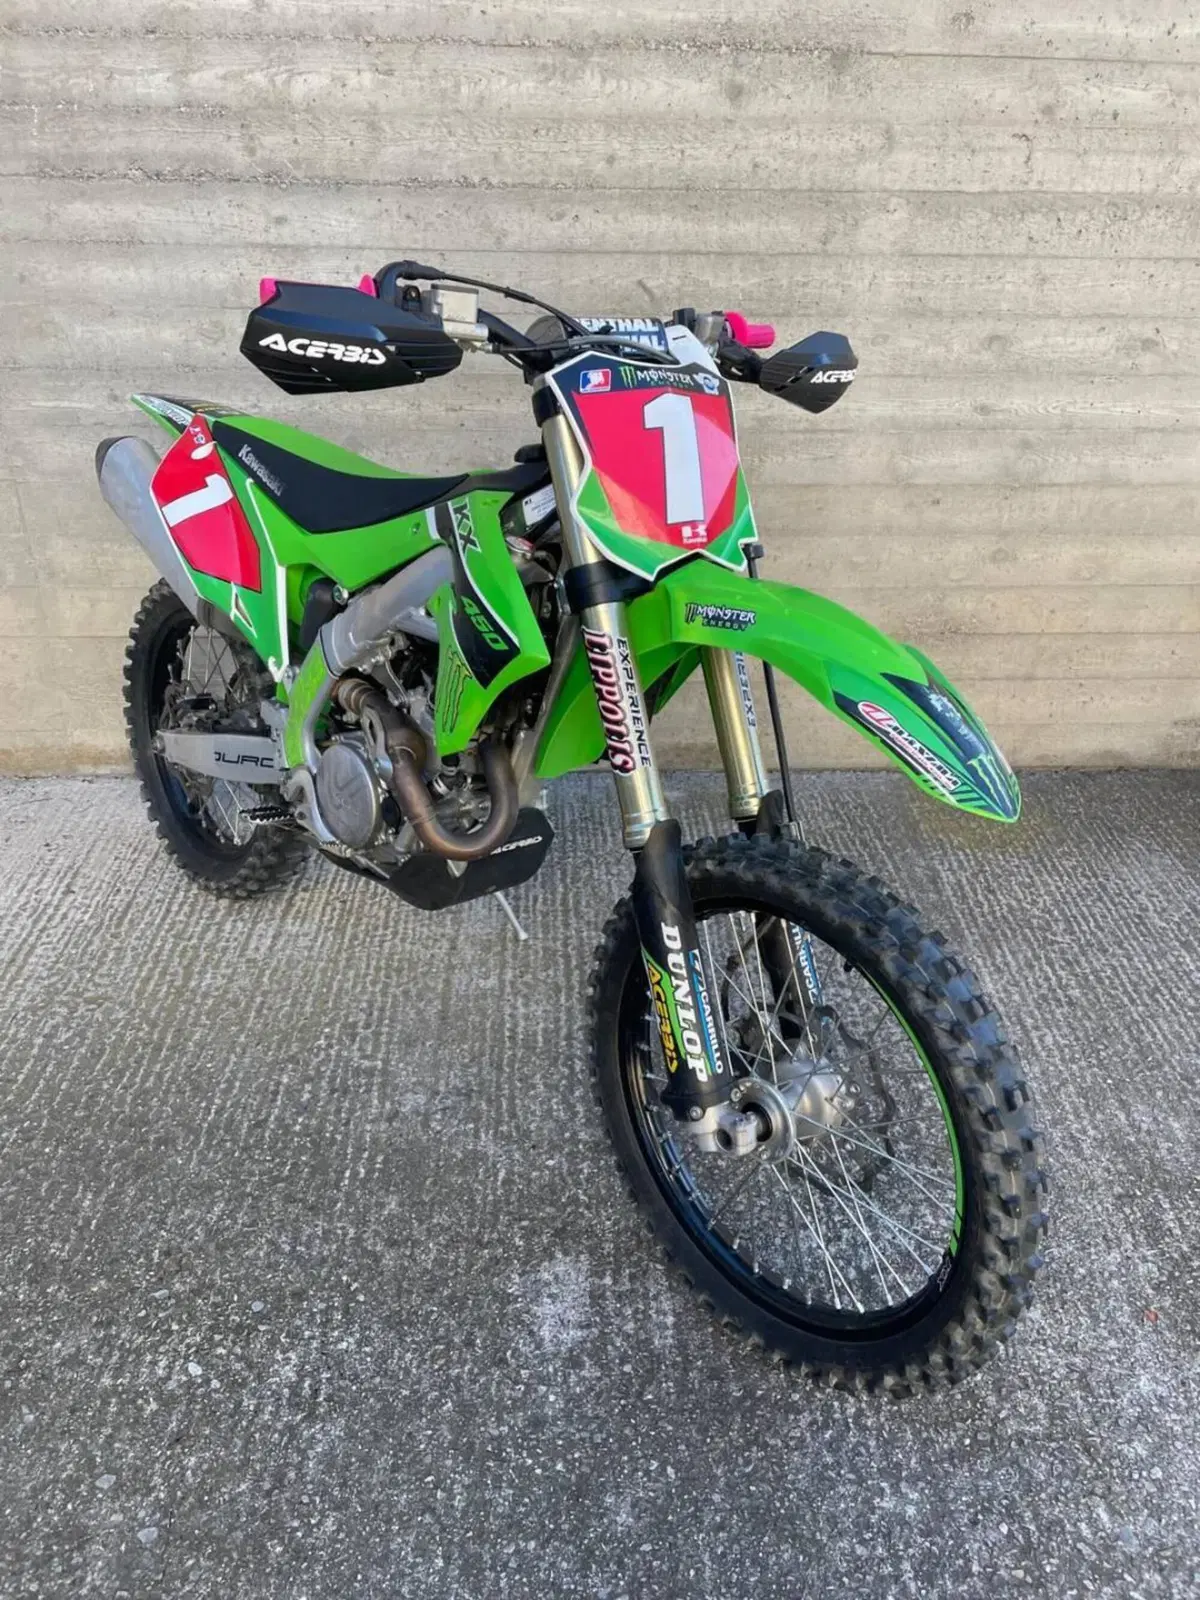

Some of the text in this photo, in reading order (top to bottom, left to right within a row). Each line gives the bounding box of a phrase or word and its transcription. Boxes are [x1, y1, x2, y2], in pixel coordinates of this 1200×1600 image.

[258, 333, 387, 365] ACERBIS
[637, 369, 695, 386] MONSTER
[238, 444, 288, 497] Kawasaki
[643, 392, 704, 524] 1
[161, 473, 234, 528] 1
[452, 502, 482, 557] KX
[461, 595, 509, 650] 450
[697, 604, 756, 624] MONSTER
[617, 637, 651, 767] EXPERIENCE
[661, 921, 709, 1083] DUNLOP
[700, 990, 724, 1075] CARRILLO
